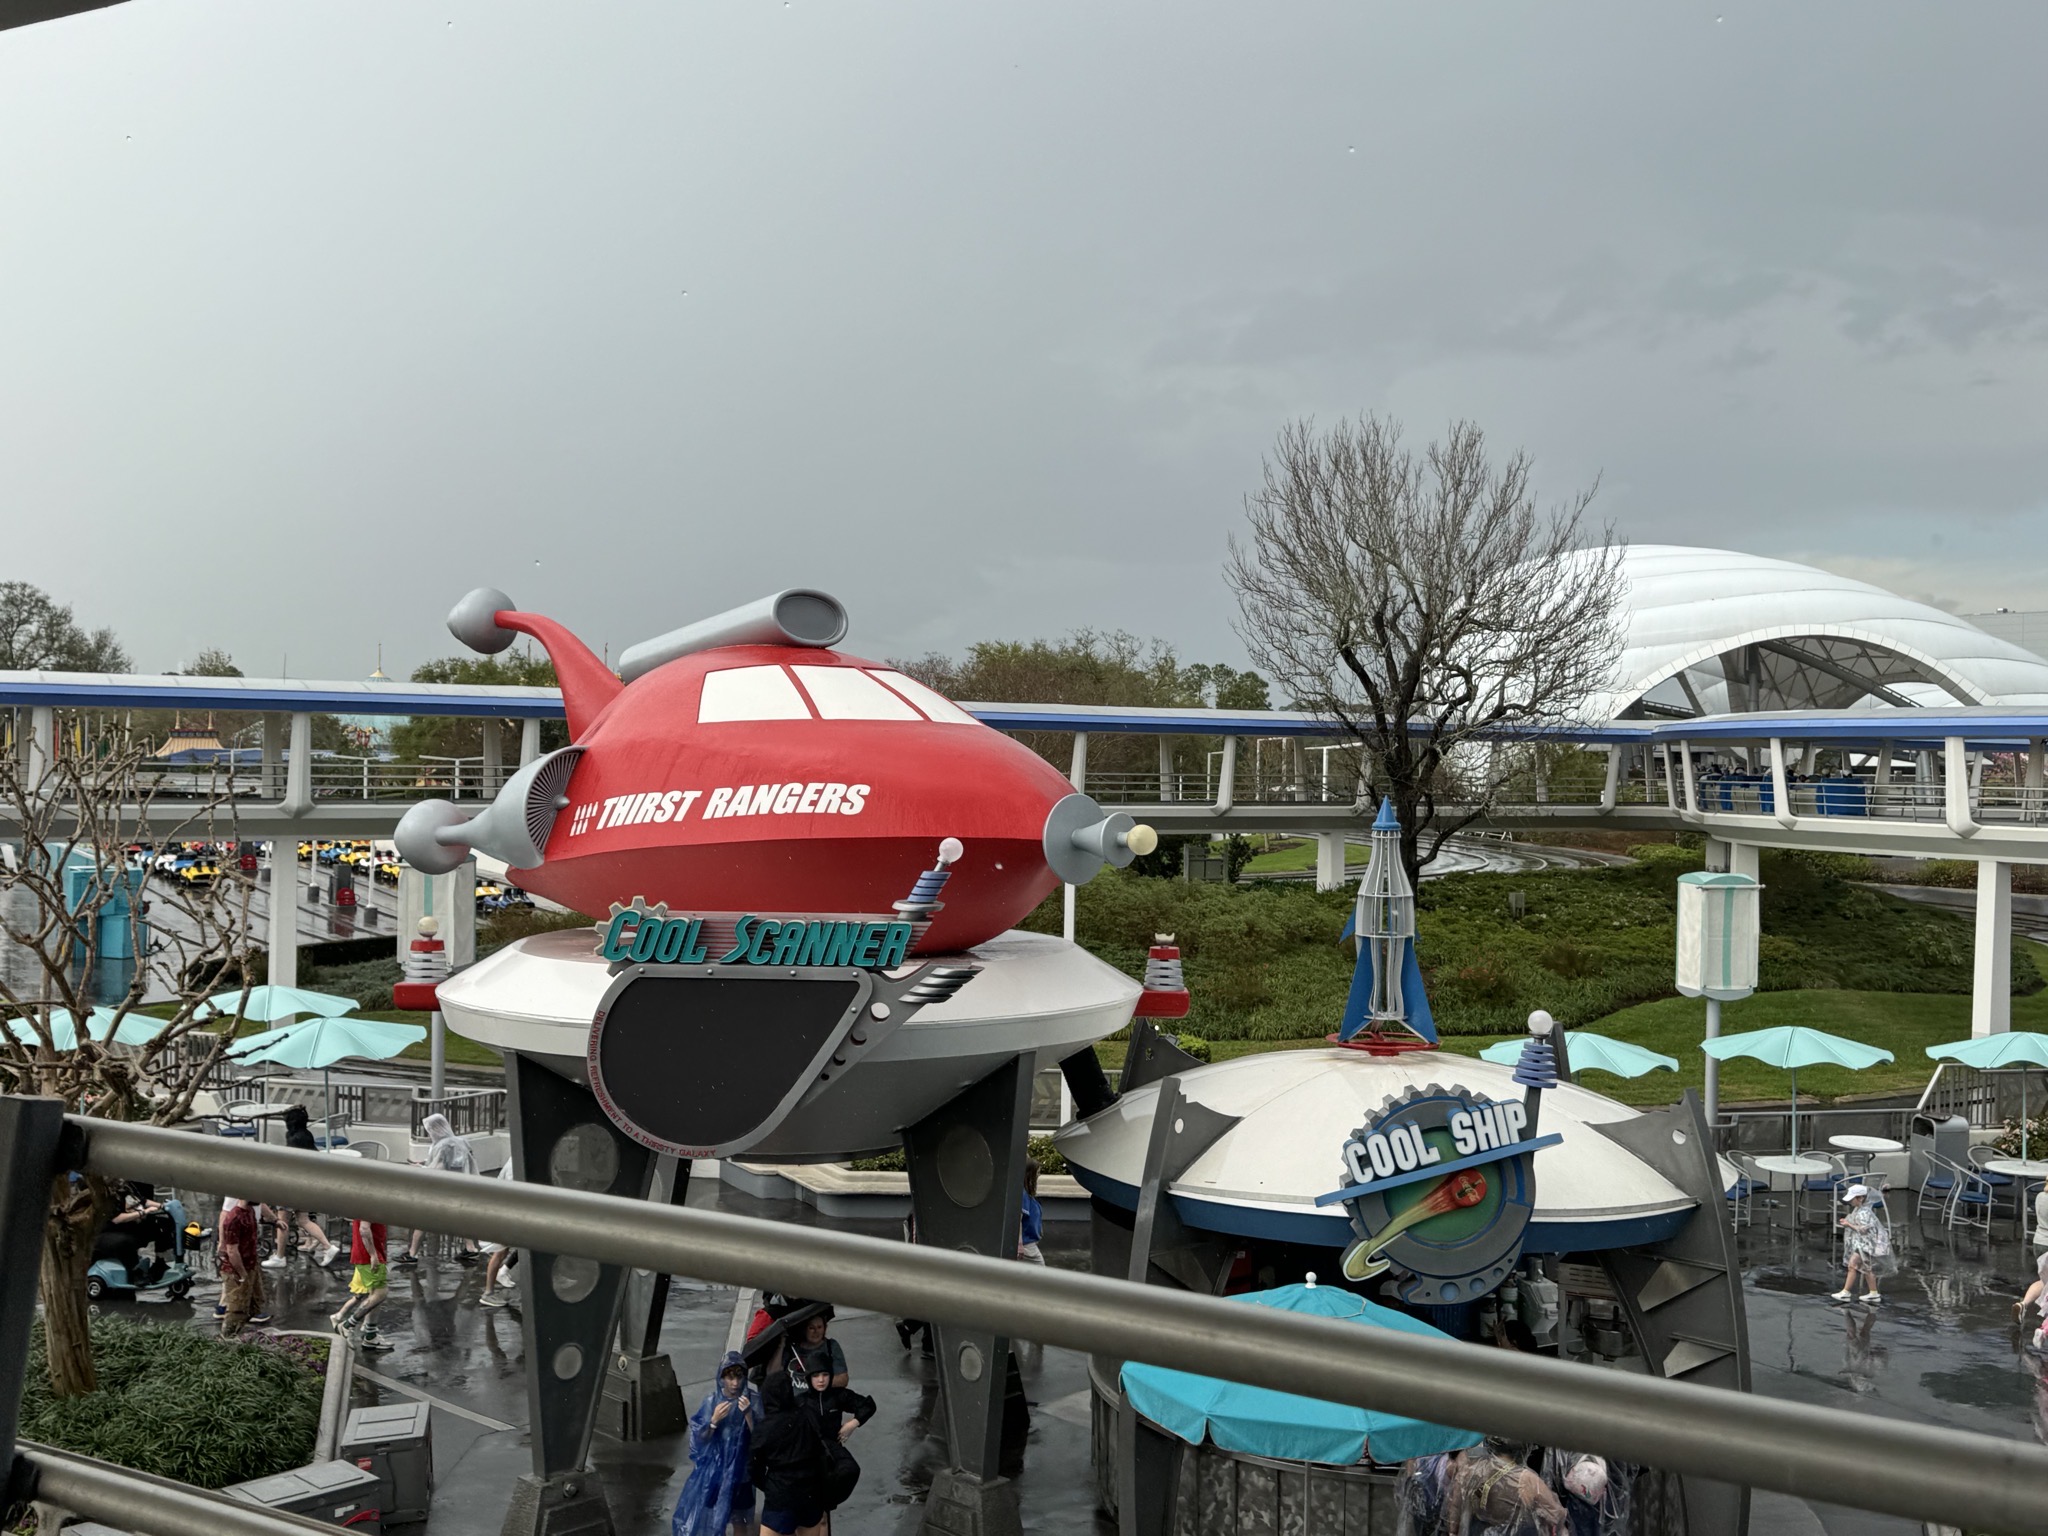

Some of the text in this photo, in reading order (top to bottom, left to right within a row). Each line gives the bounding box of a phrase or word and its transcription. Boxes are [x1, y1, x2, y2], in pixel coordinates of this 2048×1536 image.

[596, 782, 870, 830] THIRST RANGERS
[602, 910, 912, 967] COOL SCANNER
[590, 1010, 606, 1060] DELIVERING
[590, 1065, 622, 1122] REFRESHMENT
[623, 1122, 633, 1133] TO
[642, 1136, 676, 1154] THIRSTY
[1344, 1101, 1527, 1184] COOL SHIP
[679, 1148, 716, 1157] GALAXY
